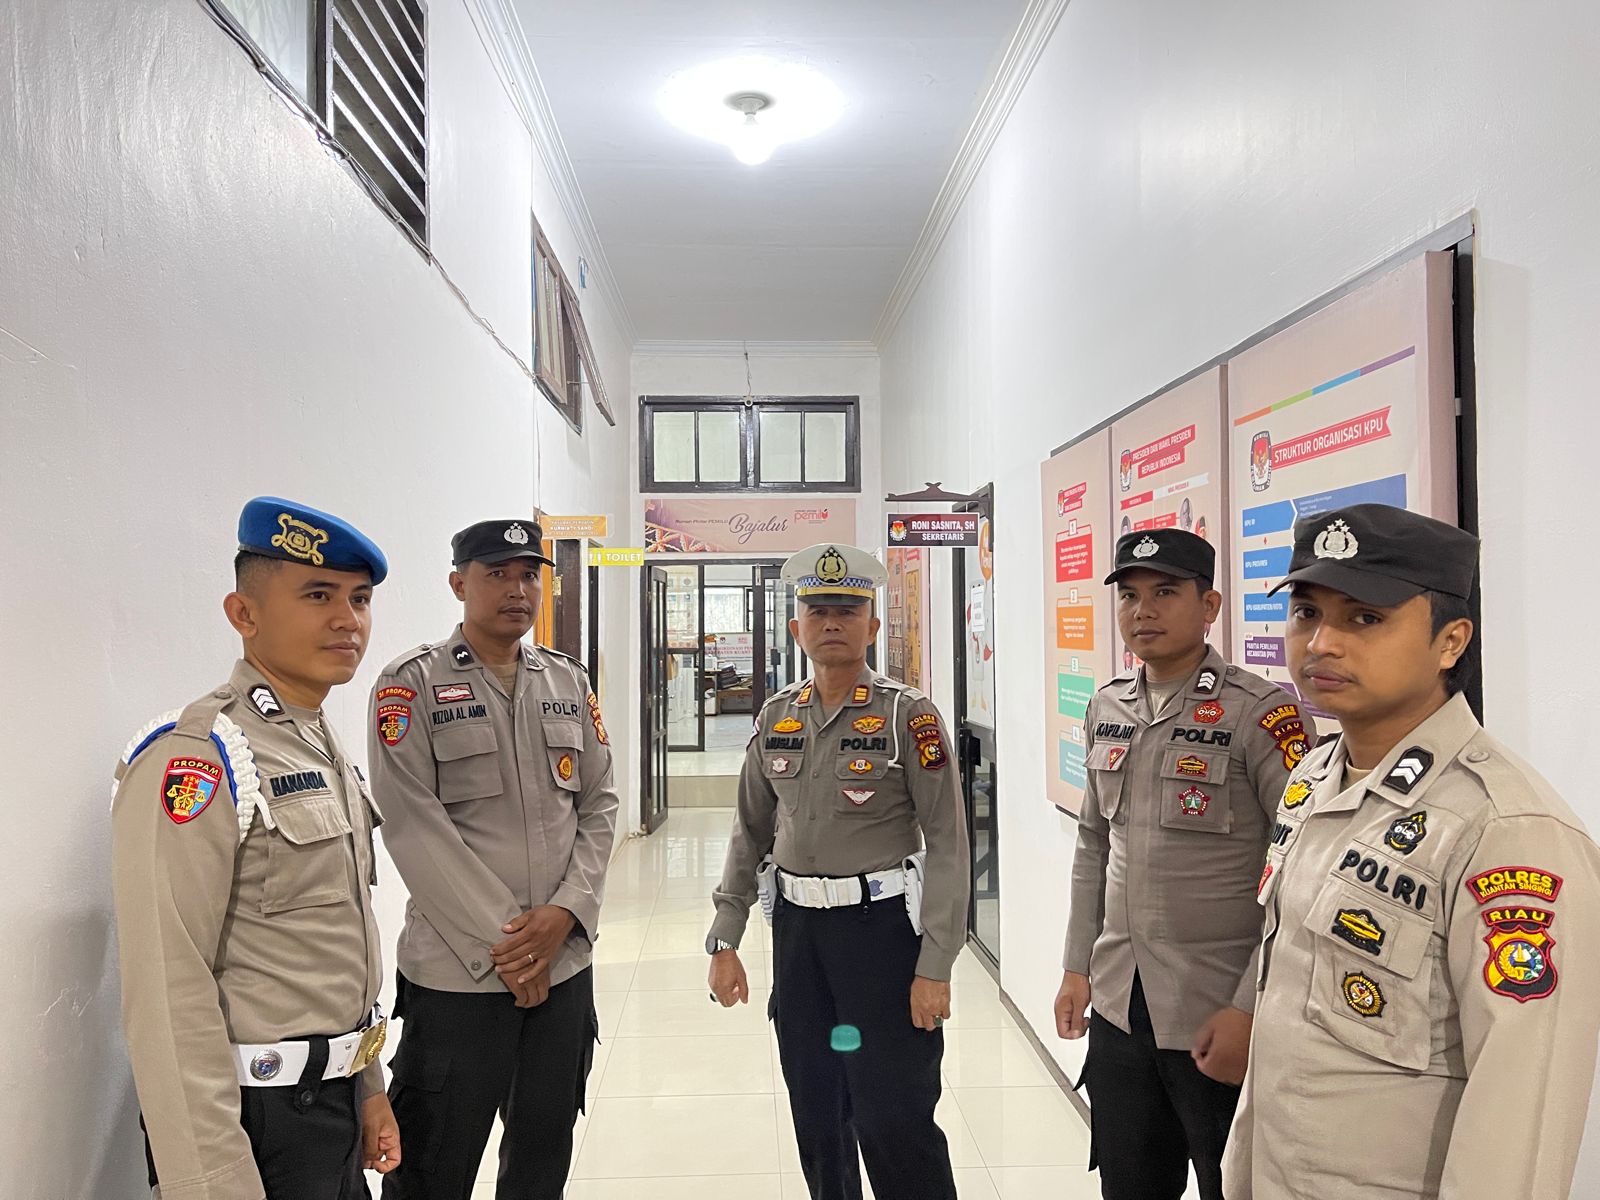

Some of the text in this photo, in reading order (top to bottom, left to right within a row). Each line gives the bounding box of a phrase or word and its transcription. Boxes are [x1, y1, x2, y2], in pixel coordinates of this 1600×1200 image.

[1274, 416, 1383, 463] STRUKTUR ORGANISASI KPU
[728, 512, 788, 545] Bajalur
[912, 521, 975, 531] RONI SASNITA, SH
[922, 533, 964, 541] SEKRETARIS
[606, 553, 641, 562] TOILET
[385, 687, 412, 698] PROPAM
[380, 705, 408, 713] PROPAM
[456, 708, 467, 720] AL
[468, 704, 487, 718] AMIN
[542, 702, 580, 718] POLR
[1262, 706, 1295, 728] POLRES
[916, 730, 937, 739] RIAU
[1095, 722, 1136, 740] KAFILAH
[1170, 727, 1232, 747] POLRI
[1274, 722, 1300, 737] RIAU
[765, 736, 805, 750] MUSLIM
[840, 737, 886, 750] POLRI
[173, 760, 218, 776] PROPAM
[269, 771, 328, 797] HANANDA
[1339, 849, 1427, 911] POLRI
[1476, 871, 1553, 890] POLRES
[1480, 882, 1553, 898] KUANTAN SINGINGI
[1490, 910, 1545, 921] RIAU
